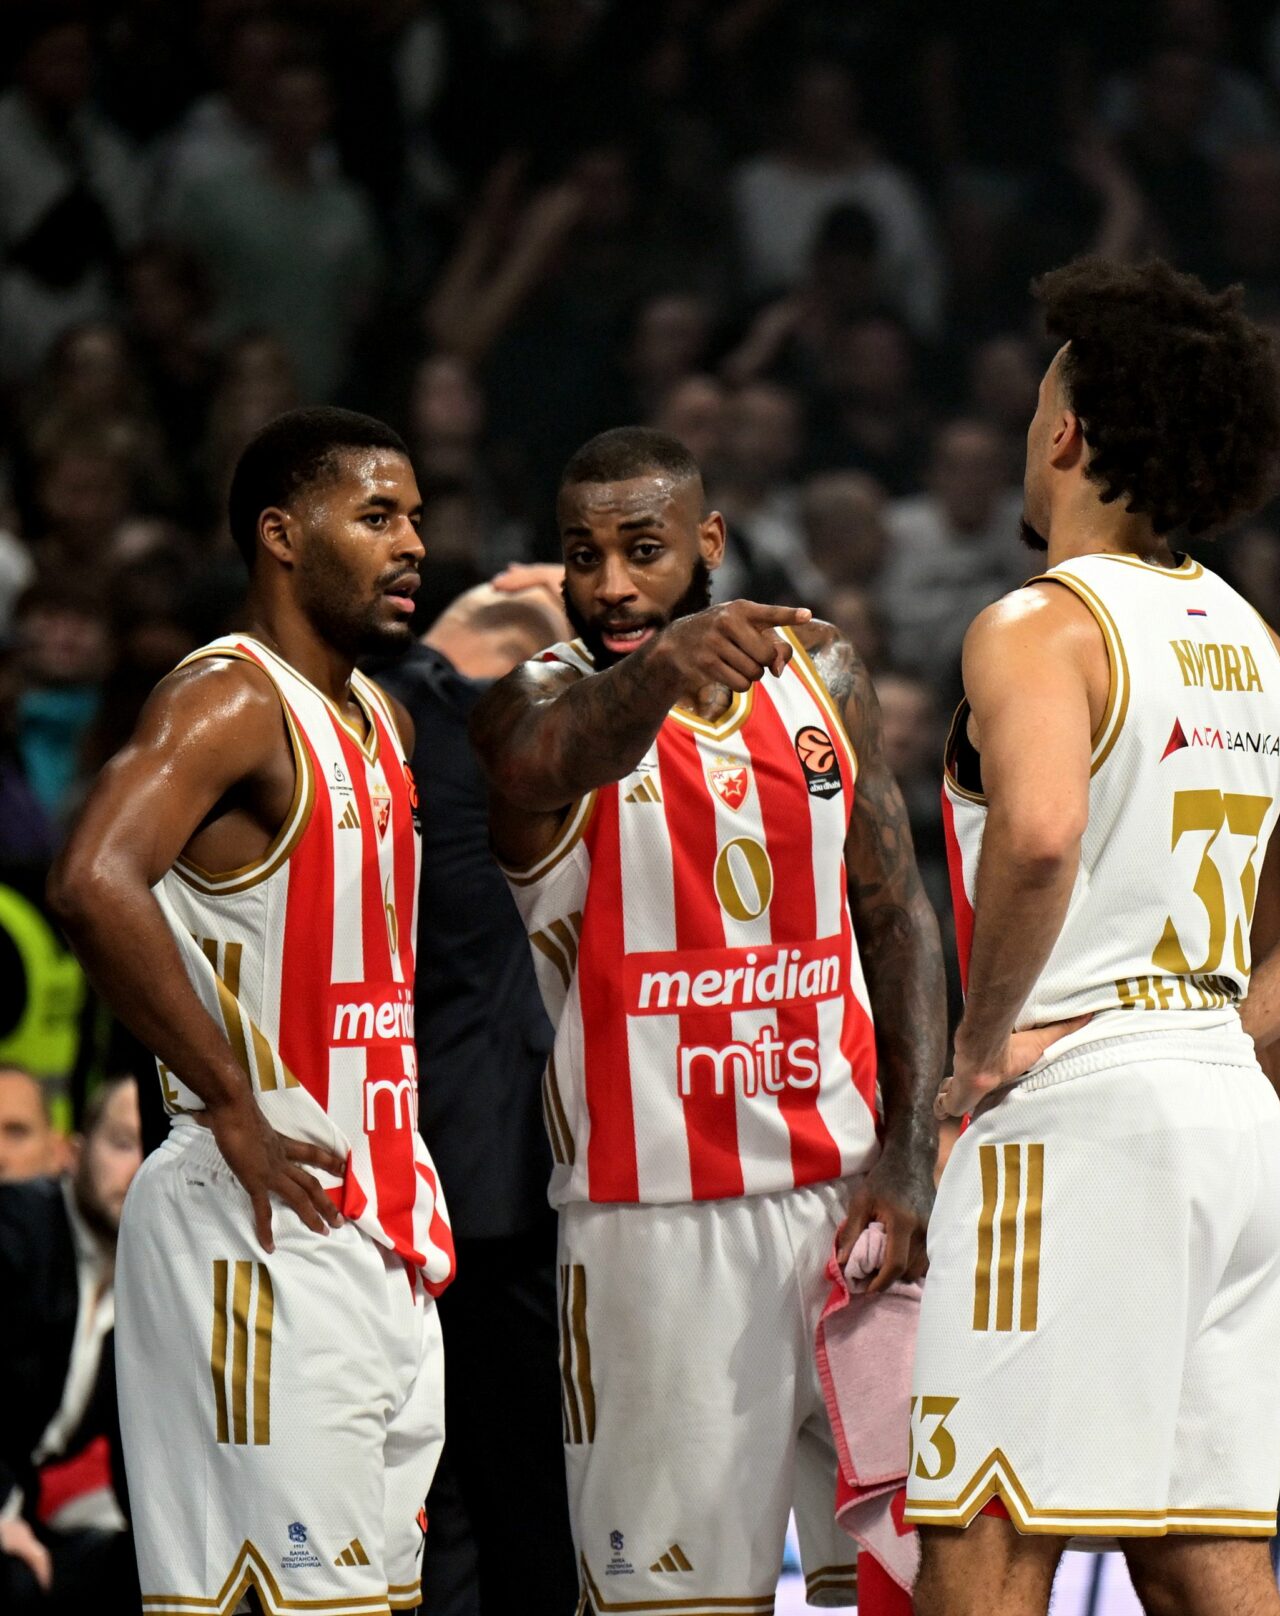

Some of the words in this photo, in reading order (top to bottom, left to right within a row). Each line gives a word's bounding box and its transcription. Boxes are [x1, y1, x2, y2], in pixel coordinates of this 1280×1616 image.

[1226, 730, 1280, 757] BANKA
[713, 836, 774, 922] 0
[1151, 788, 1274, 977] 33
[637, 949, 841, 1009] meridian
[680, 1030, 820, 1096] mts
